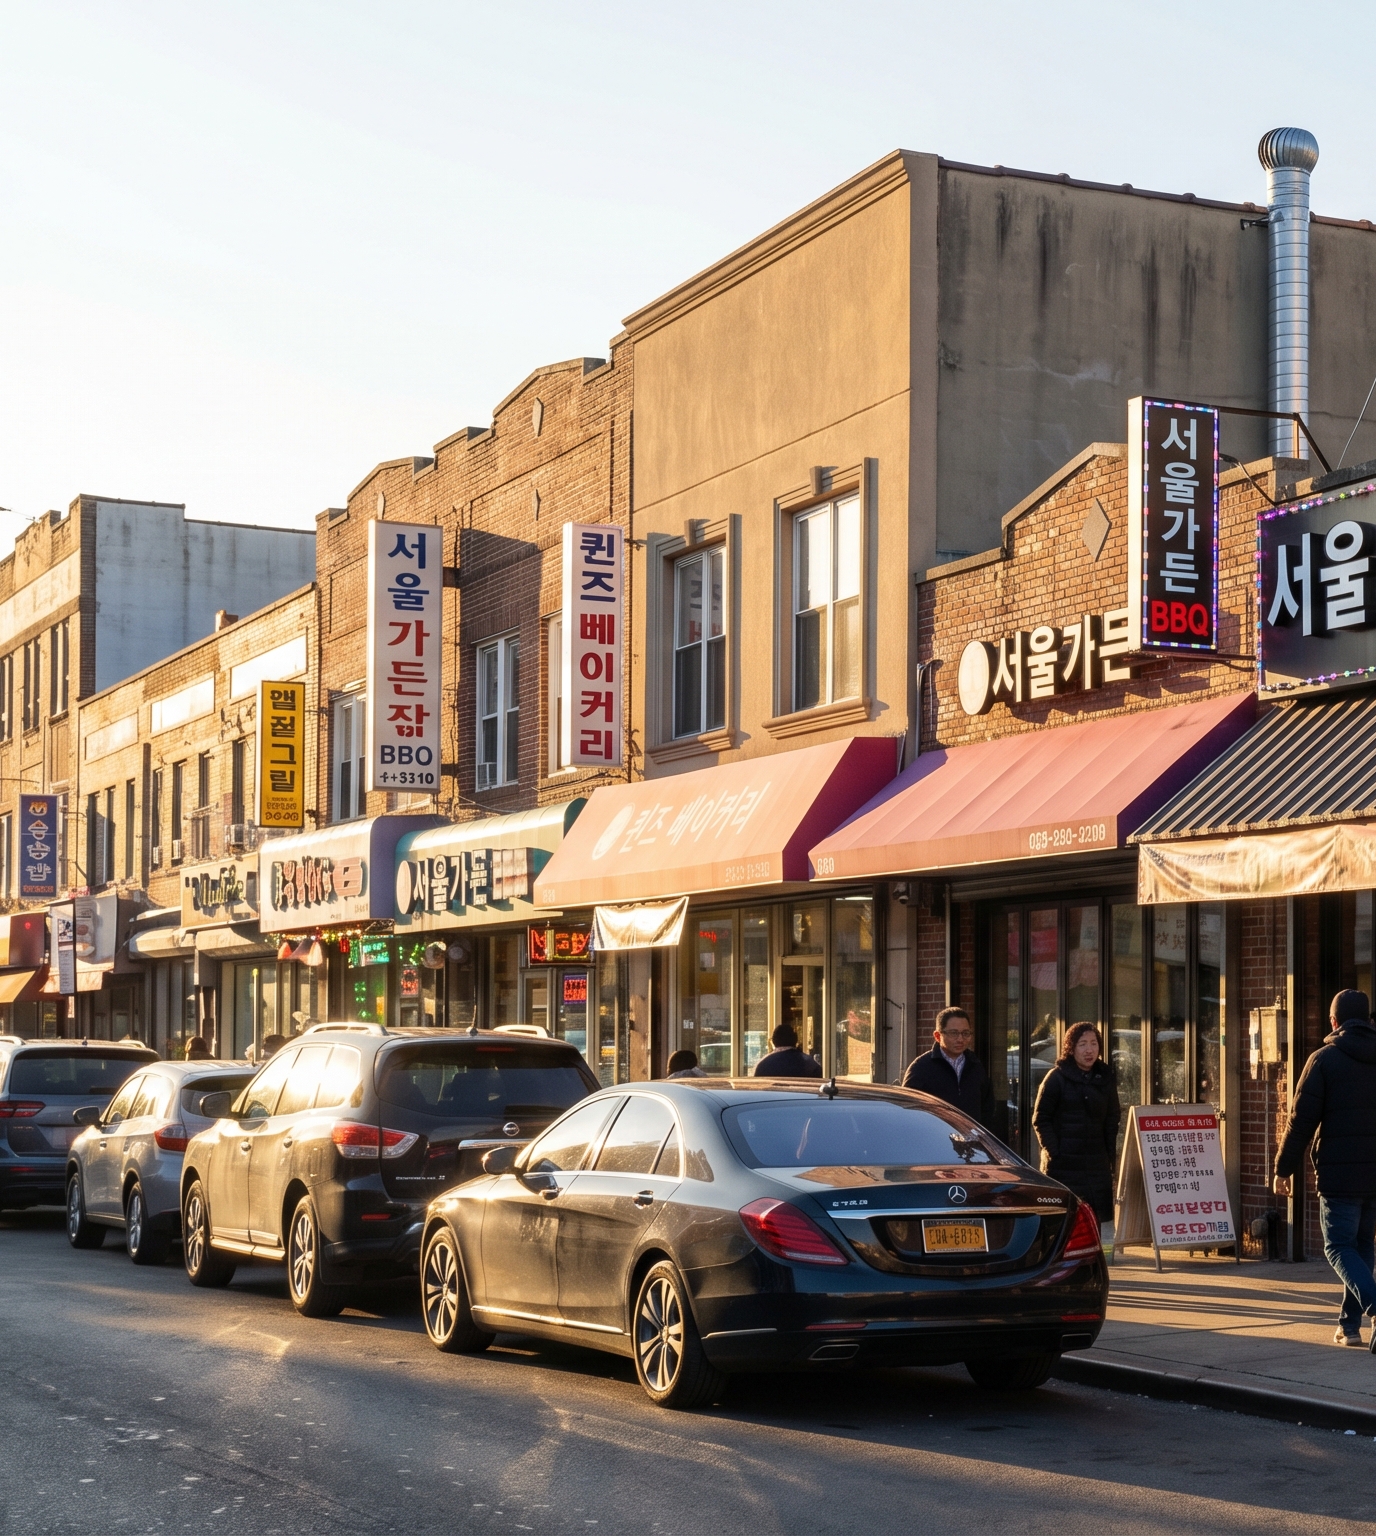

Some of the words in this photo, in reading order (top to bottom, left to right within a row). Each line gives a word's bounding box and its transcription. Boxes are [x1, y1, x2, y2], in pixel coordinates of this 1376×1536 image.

[1160, 418, 1200, 593] 서울가든
[580, 532, 615, 759] 퀸즈베이커리
[1150, 601, 1209, 637] BBQ
[621, 804, 673, 853] 퀸즈
[667, 782, 771, 844] 베이커리
